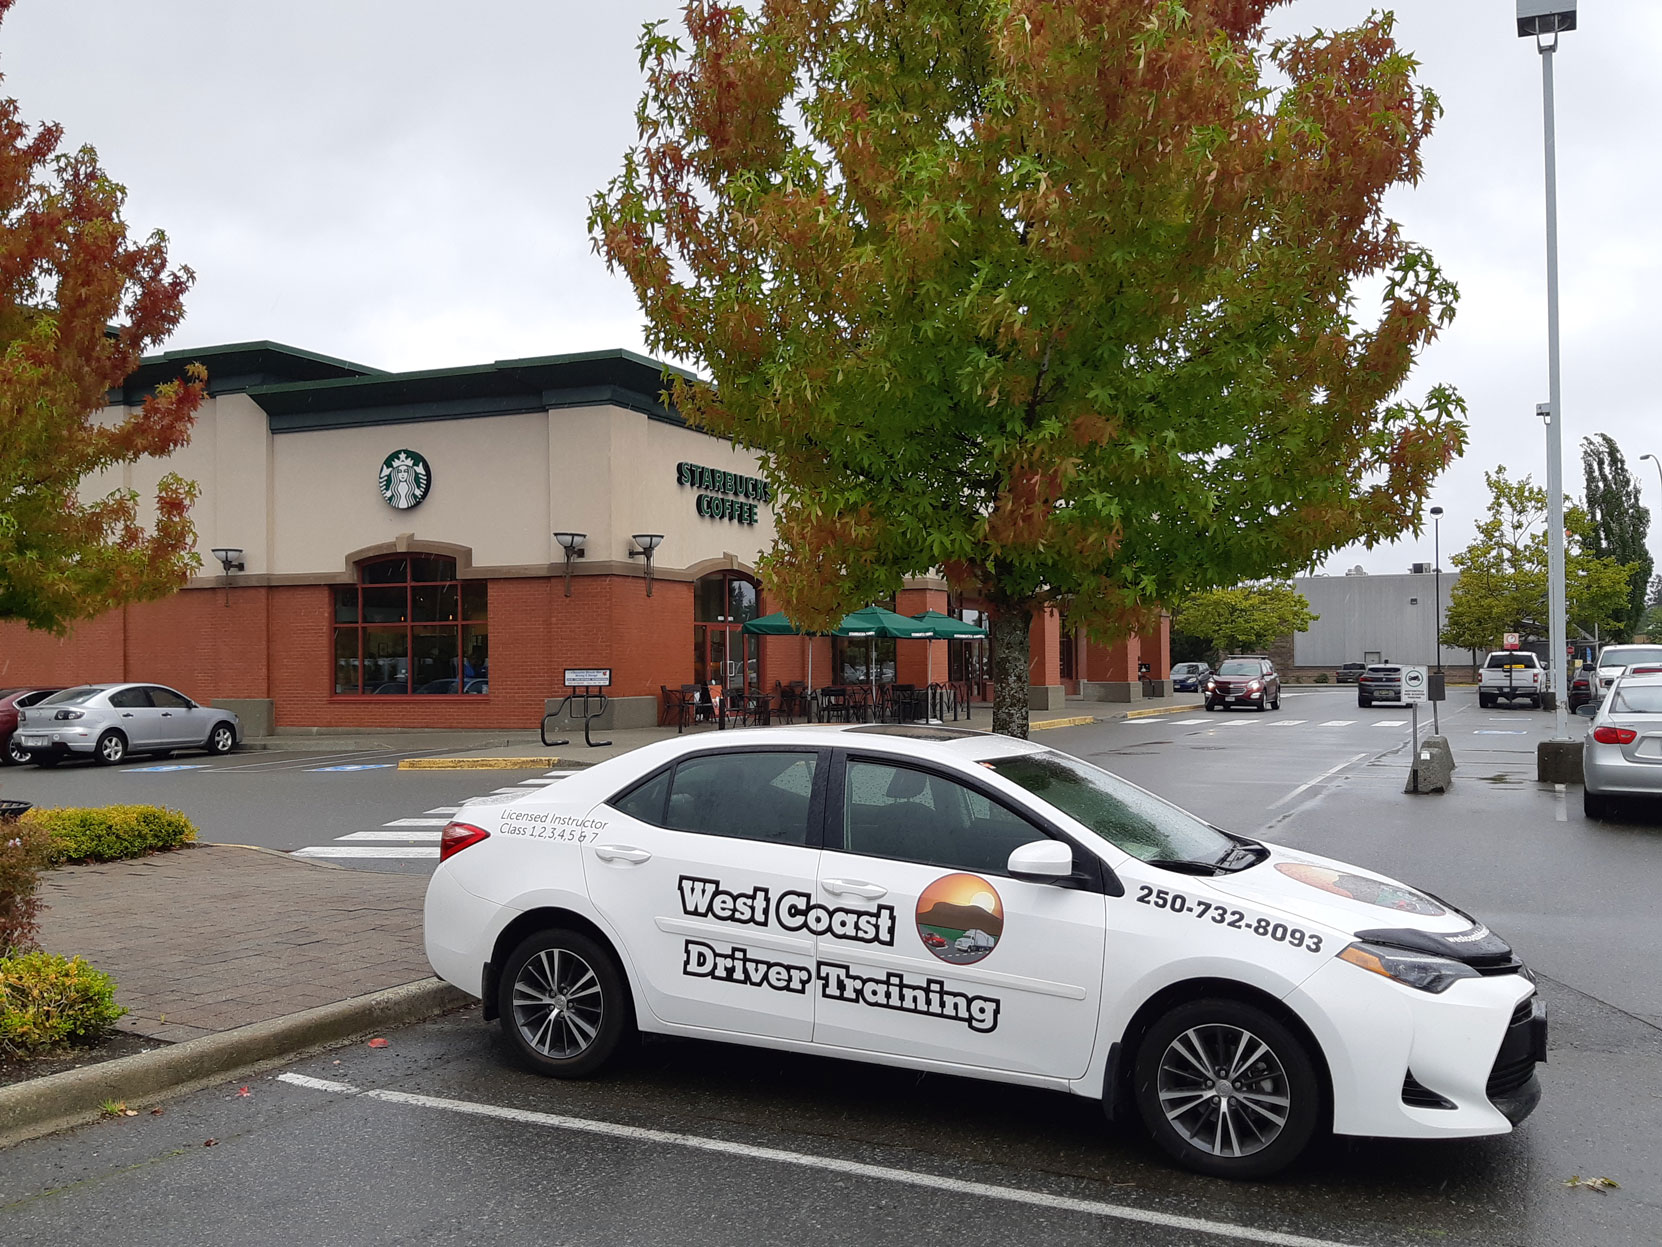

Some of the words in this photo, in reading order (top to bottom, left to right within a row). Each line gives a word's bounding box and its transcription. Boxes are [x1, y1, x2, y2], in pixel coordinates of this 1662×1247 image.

[696, 494, 758, 524] COFFEE
[499, 822, 527, 835] Class
[529, 826, 576, 842] 1,2,3,4,5
[590, 832, 598, 843] 7
[501, 809, 549, 823] Licensed
[550, 813, 609, 830] Instructor
[678, 874, 769, 927] West
[775, 889, 896, 946] Coast
[1136, 885, 1324, 954] 250-732-8093
[683, 939, 812, 994] Driver
[817, 960, 1000, 1033] Training
